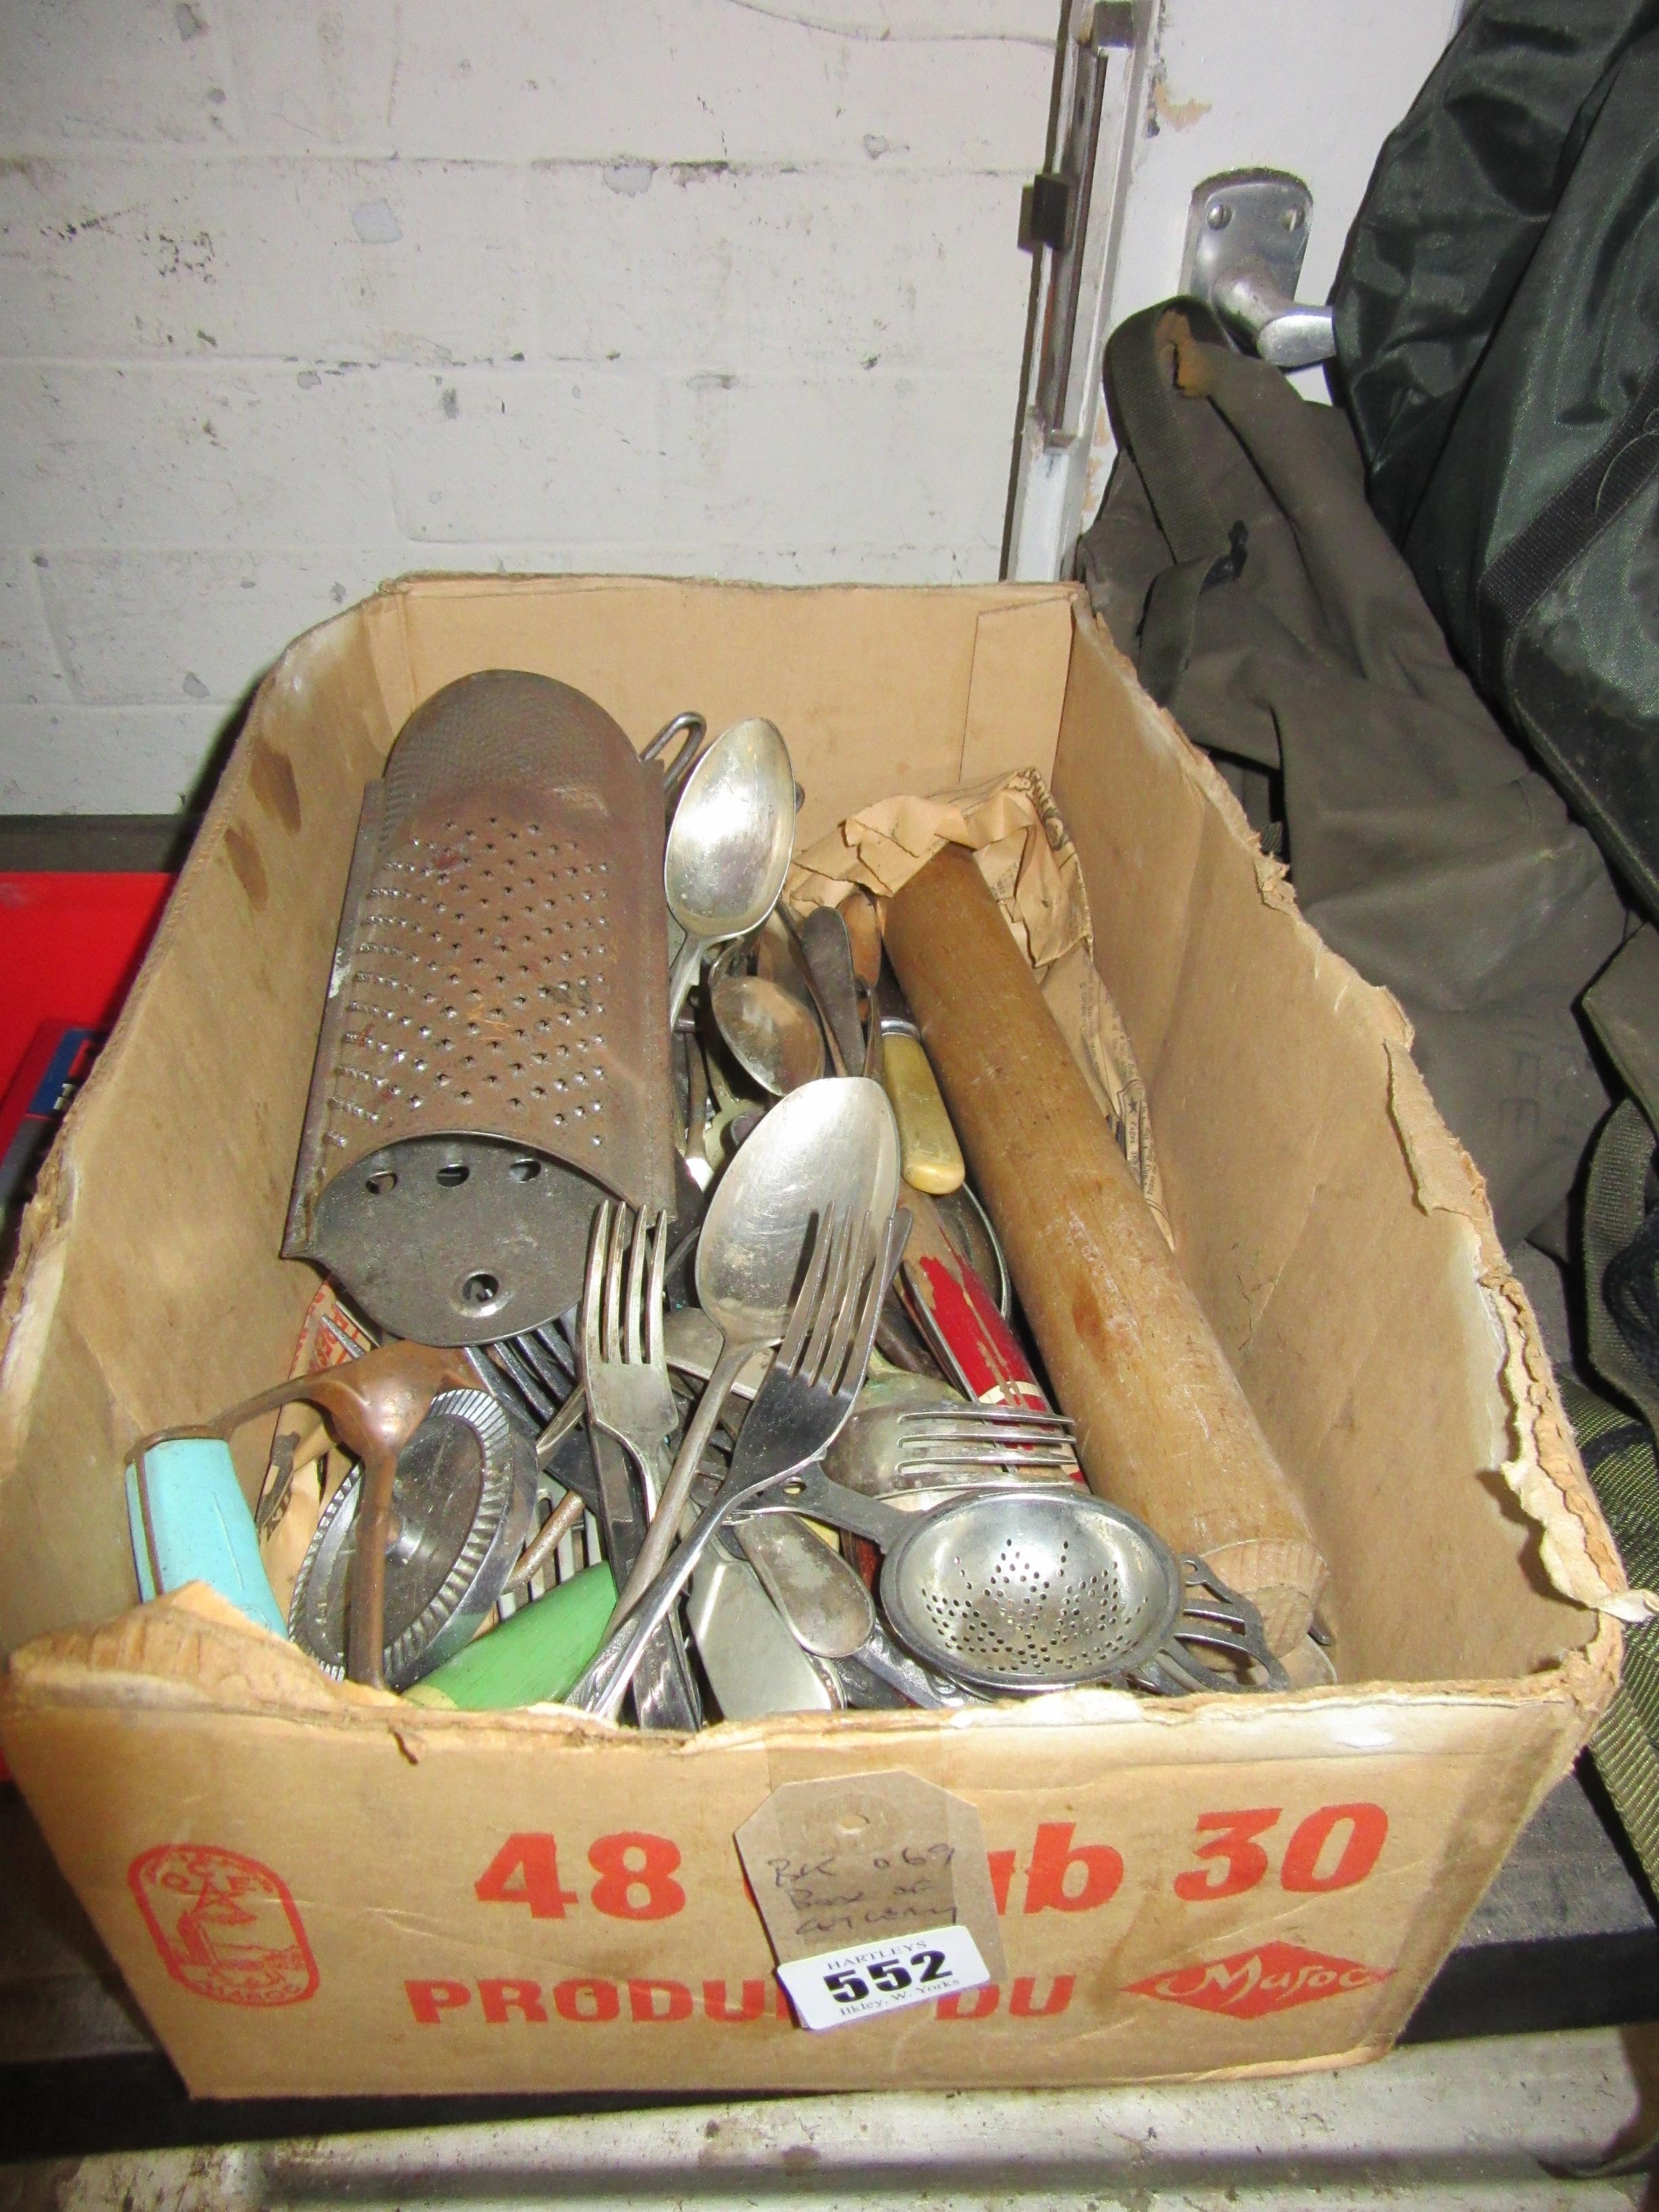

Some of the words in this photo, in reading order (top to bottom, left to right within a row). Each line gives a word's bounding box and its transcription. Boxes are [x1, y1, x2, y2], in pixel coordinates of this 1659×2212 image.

[474, 1830, 686, 1921] 48
[1174, 1802, 1389, 1902] 30
[823, 1950, 953, 2003] 552
[827, 1940, 928, 1971] HARTLEYS
[1160, 1953, 1378, 2007] Maroc
[890, 1990, 912, 2001] W.
[916, 1978, 960, 1994] Yorks
